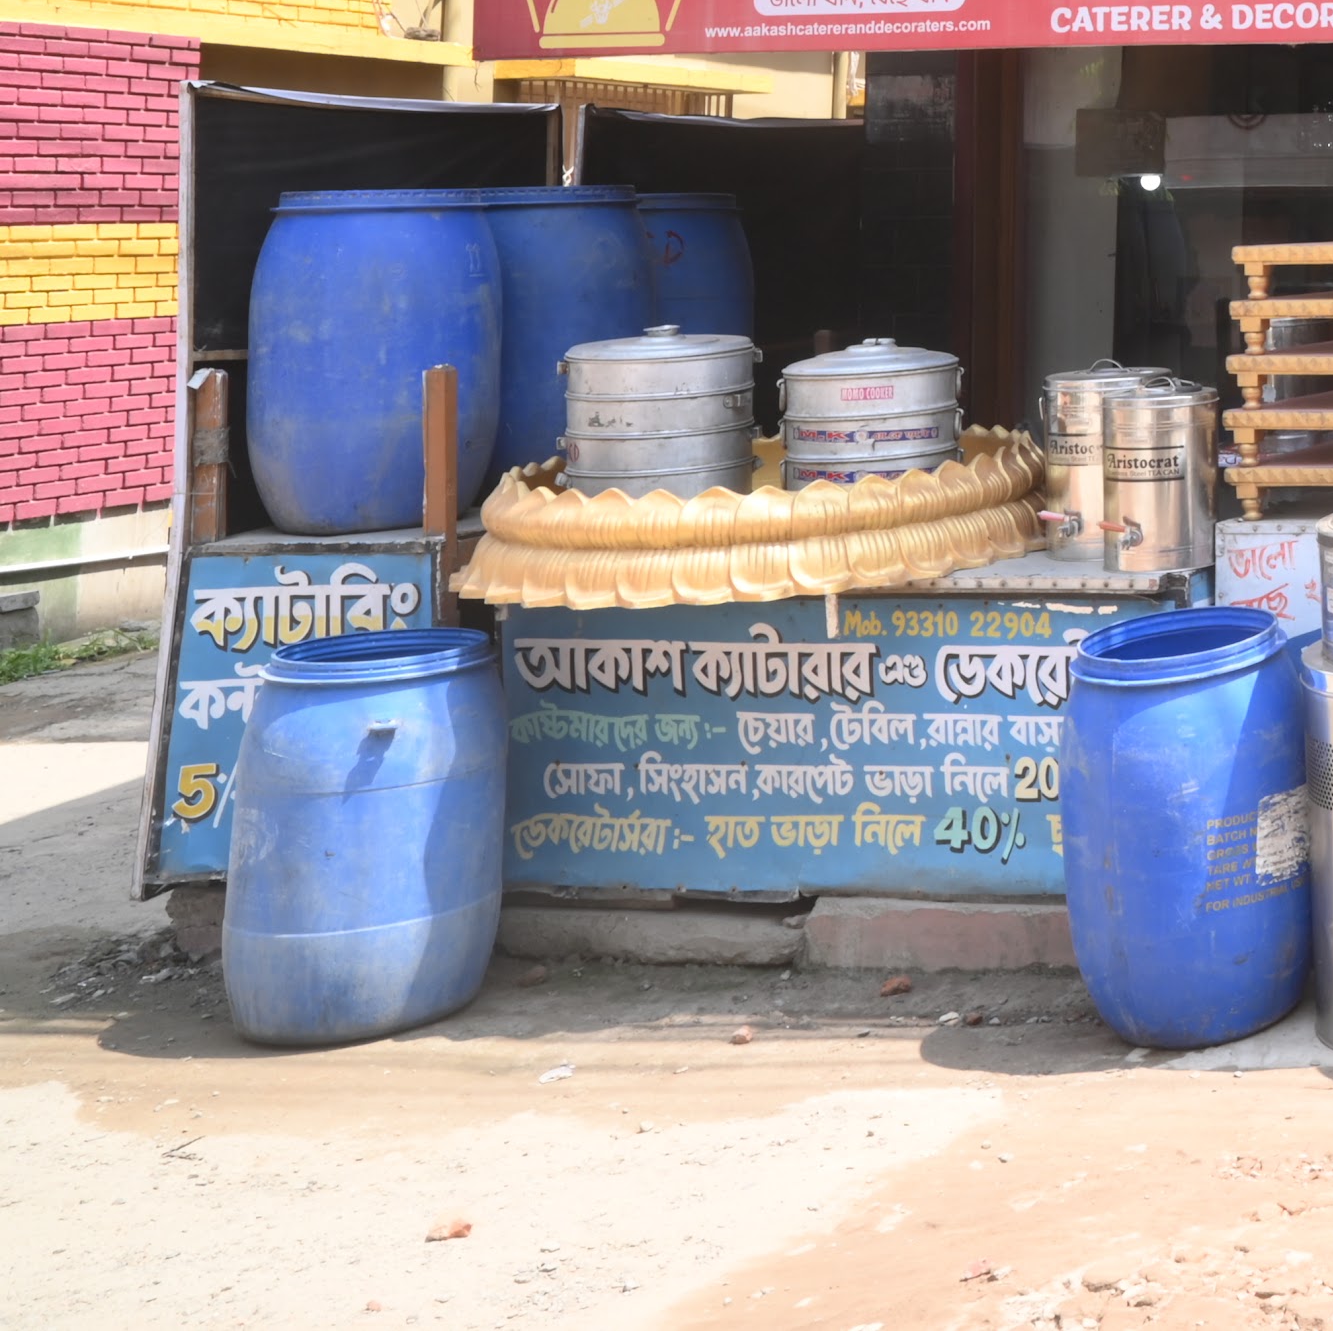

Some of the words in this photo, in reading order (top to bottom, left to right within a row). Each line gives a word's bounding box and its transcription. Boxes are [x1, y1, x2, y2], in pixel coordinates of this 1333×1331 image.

[704, 18, 991, 41] www.aakashcatereranddecoraters.com
[1050, 4, 1195, 33] CATERER
[1200, 3, 1224, 31] &
[841, 388, 864, 401] MOMO
[865, 386, 893, 400] COOKER
[1107, 453, 1179, 470] Aristocrat
[844, 609, 889, 638] Mob.
[892, 611, 959, 637] 93310
[970, 611, 1052, 639] 22904
[513, 637, 688, 694] আকাশ
[689, 622, 880, 702] ক্যাটারার
[736, 711, 815, 755] চেয়ার
[637, 751, 749, 804] সিংহাসন
[863, 765, 935, 804] ভাড়া
[940, 752, 1010, 803] নিলে
[770, 815, 844, 855] ভাড়া
[851, 801, 927, 856] নিলে
[934, 806, 1026, 864] 40%
[1206, 811, 1258, 830] PRODUC
